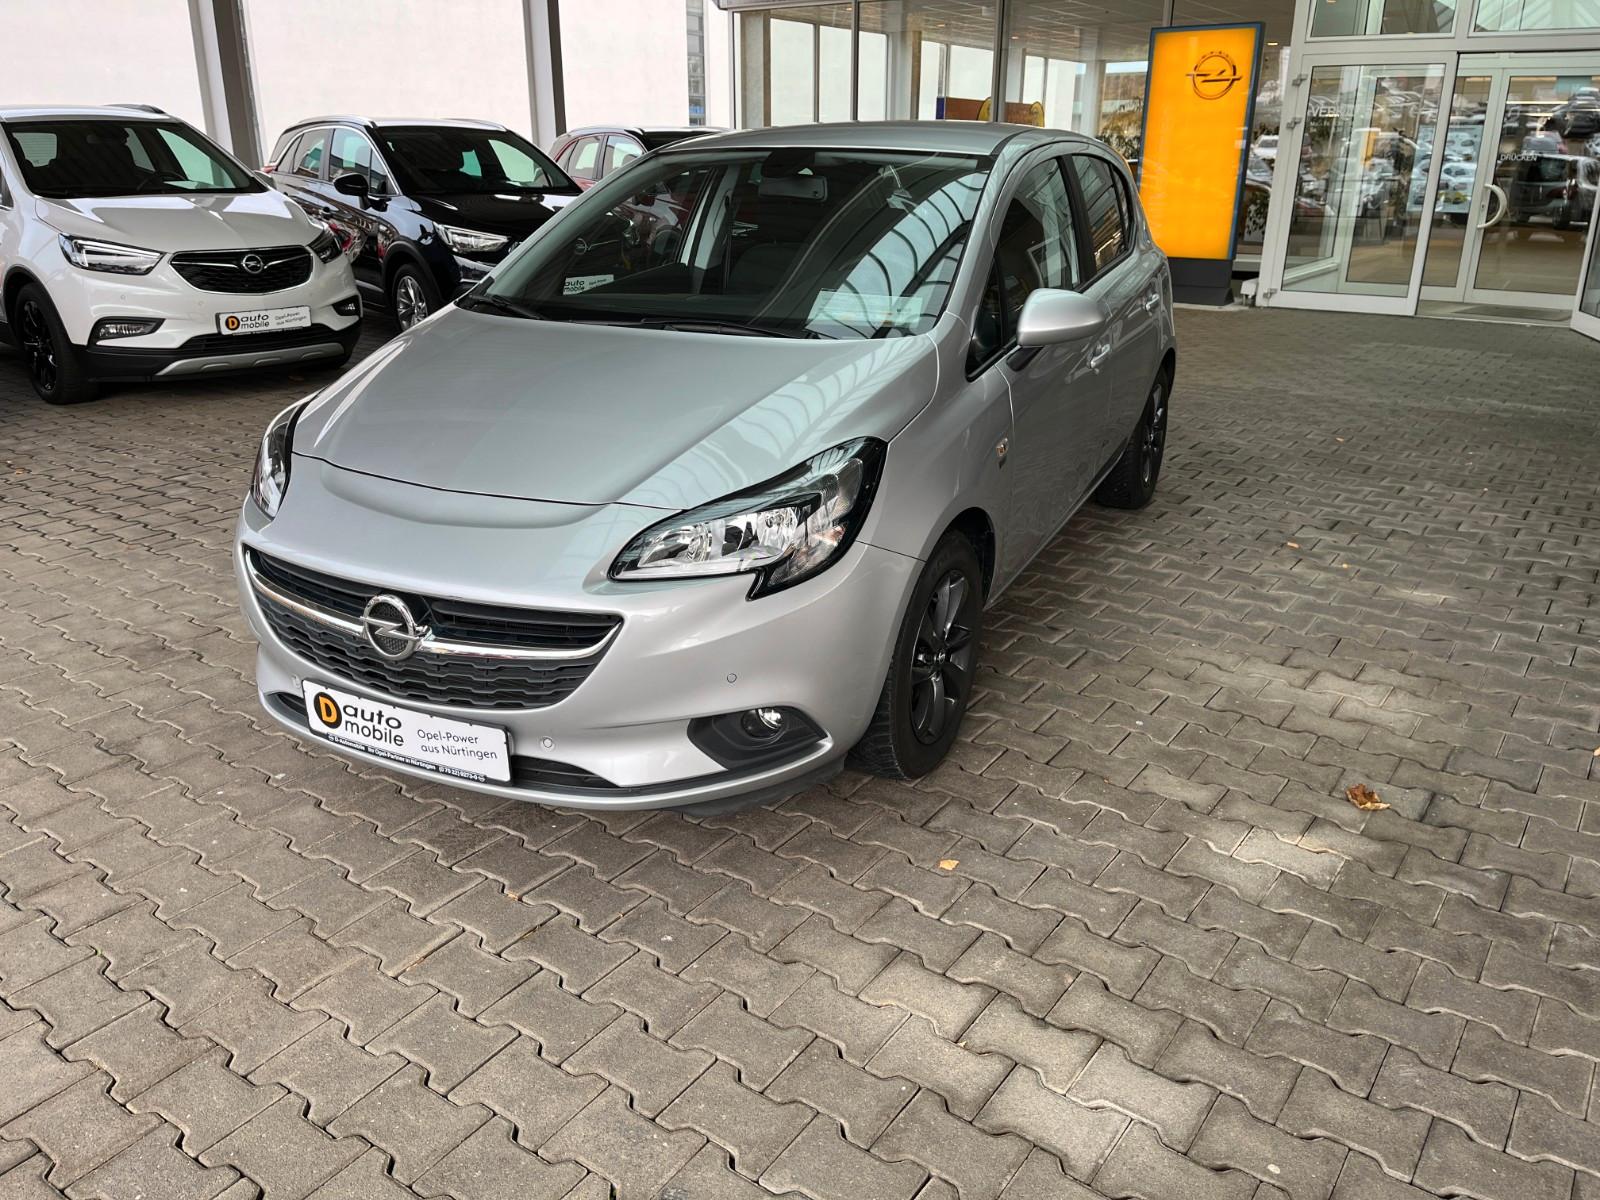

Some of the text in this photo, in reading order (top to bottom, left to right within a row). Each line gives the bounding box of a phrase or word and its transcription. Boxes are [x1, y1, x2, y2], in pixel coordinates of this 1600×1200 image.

[229, 318, 238, 329] D
[240, 313, 269, 322] auto
[240, 320, 270, 329] mobile
[319, 696, 337, 723] D
[343, 704, 402, 729] auto
[344, 719, 405, 747] mobile
[416, 729, 479, 744] Opel-Power
[421, 743, 498, 760] aus Nürtingen
